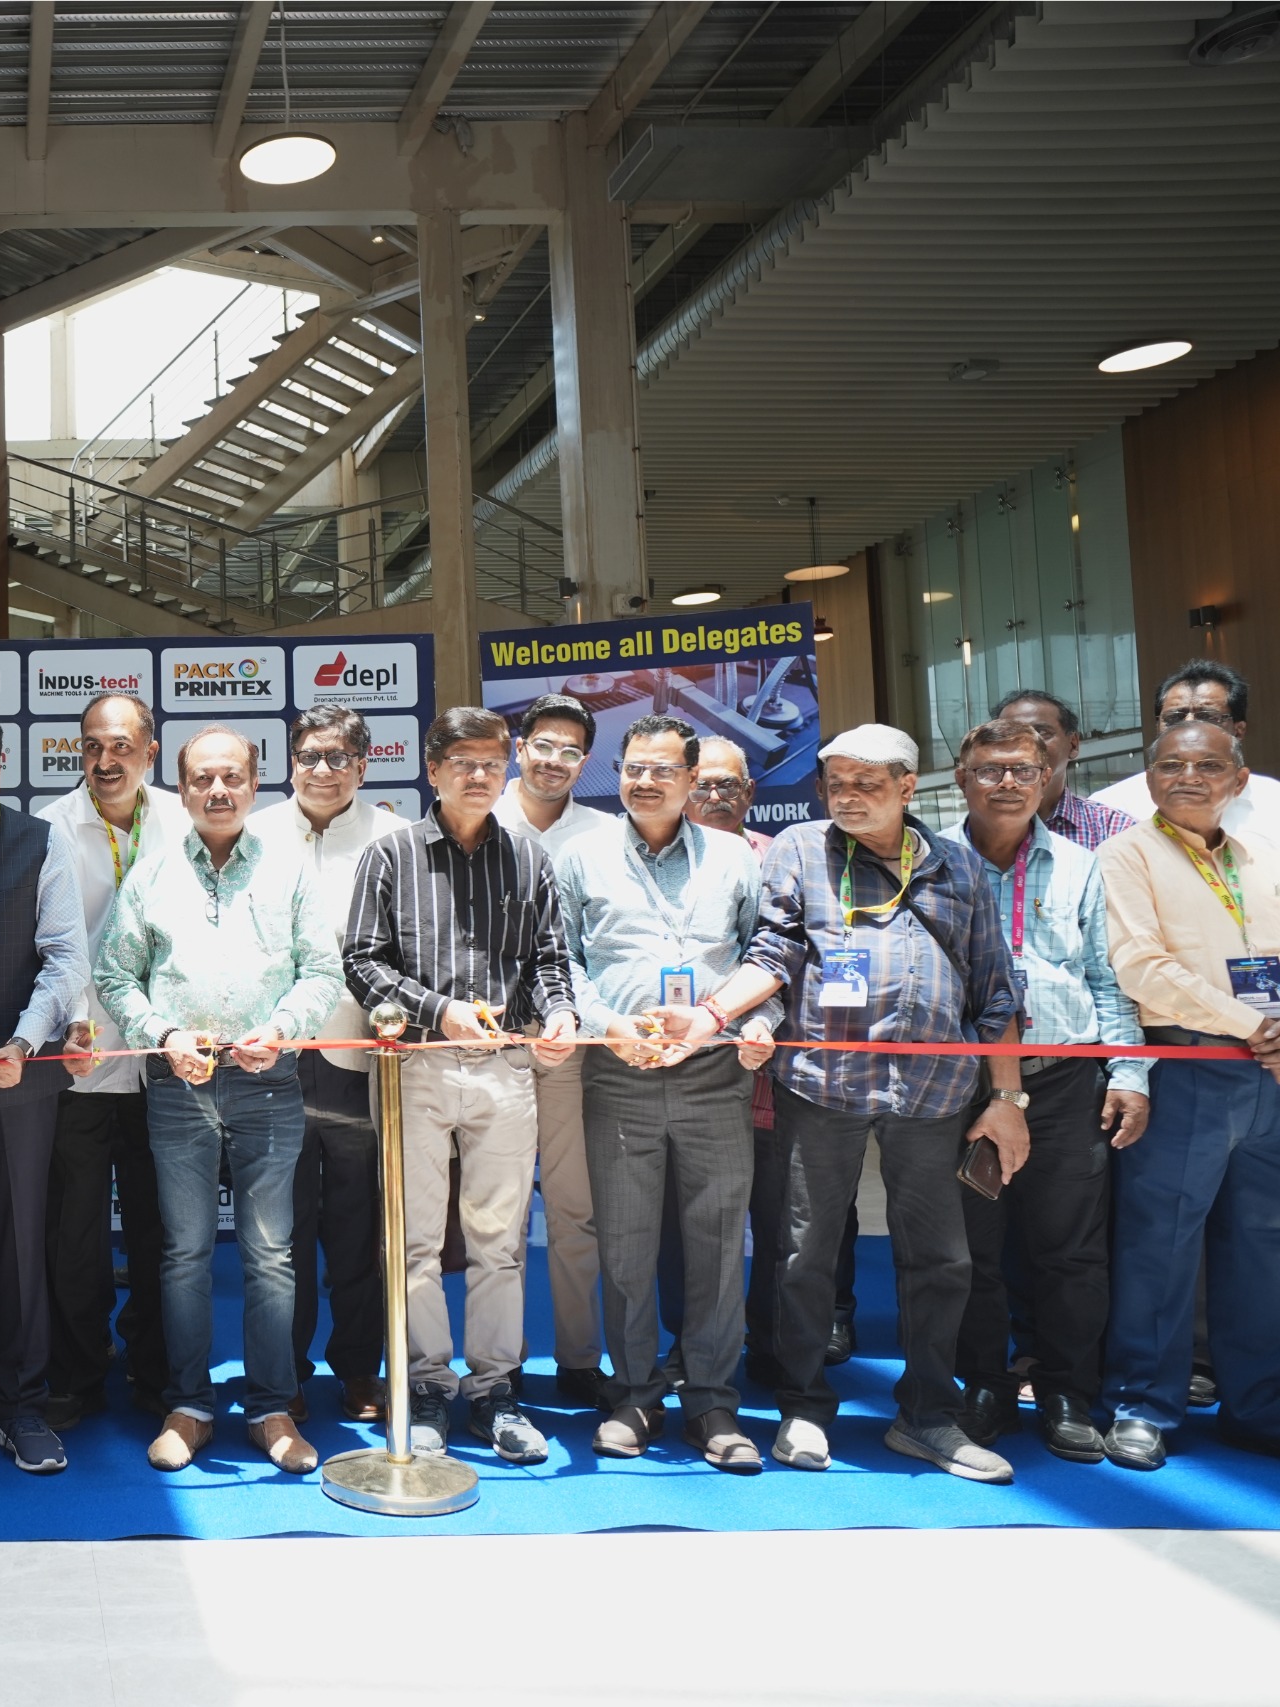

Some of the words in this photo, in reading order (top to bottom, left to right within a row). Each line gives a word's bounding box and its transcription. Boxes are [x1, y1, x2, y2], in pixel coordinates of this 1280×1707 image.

[491, 639, 610, 667] Welcome
[620, 630, 652, 658] all
[662, 620, 803, 654] Delegates
[174, 663, 235, 679] PACK
[343, 662, 397, 691] depl
[174, 680, 272, 697] PRINTEX
[42, 738, 84, 753] PAC
[745, 802, 811, 823] TWORK
